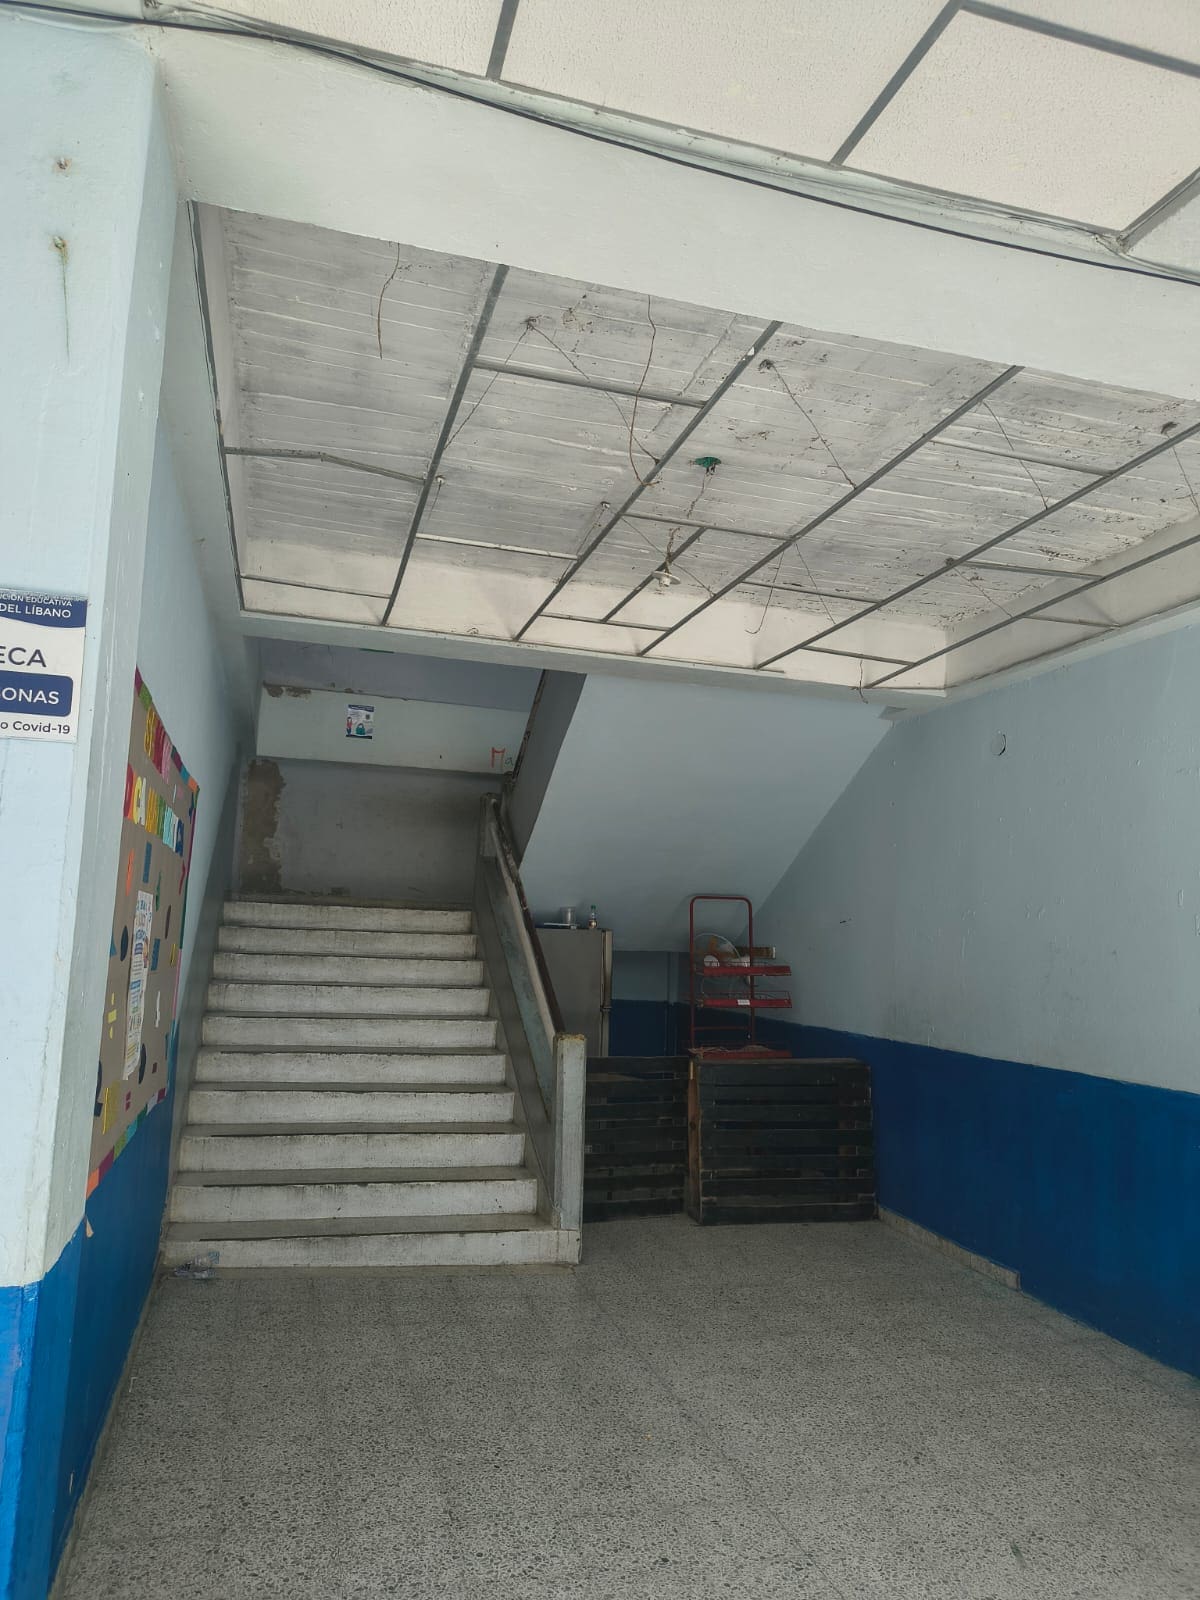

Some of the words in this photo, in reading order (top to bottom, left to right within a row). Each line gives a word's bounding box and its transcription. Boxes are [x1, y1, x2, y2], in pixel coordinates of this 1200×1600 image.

[25, 595, 72, 607] EDUCATIVA
[0, 603, 22, 613] DEL
[25, 605, 72, 618] LÍBANO
[0, 687, 60, 705] ONAS
[12, 720, 71, 734] Covid-19
